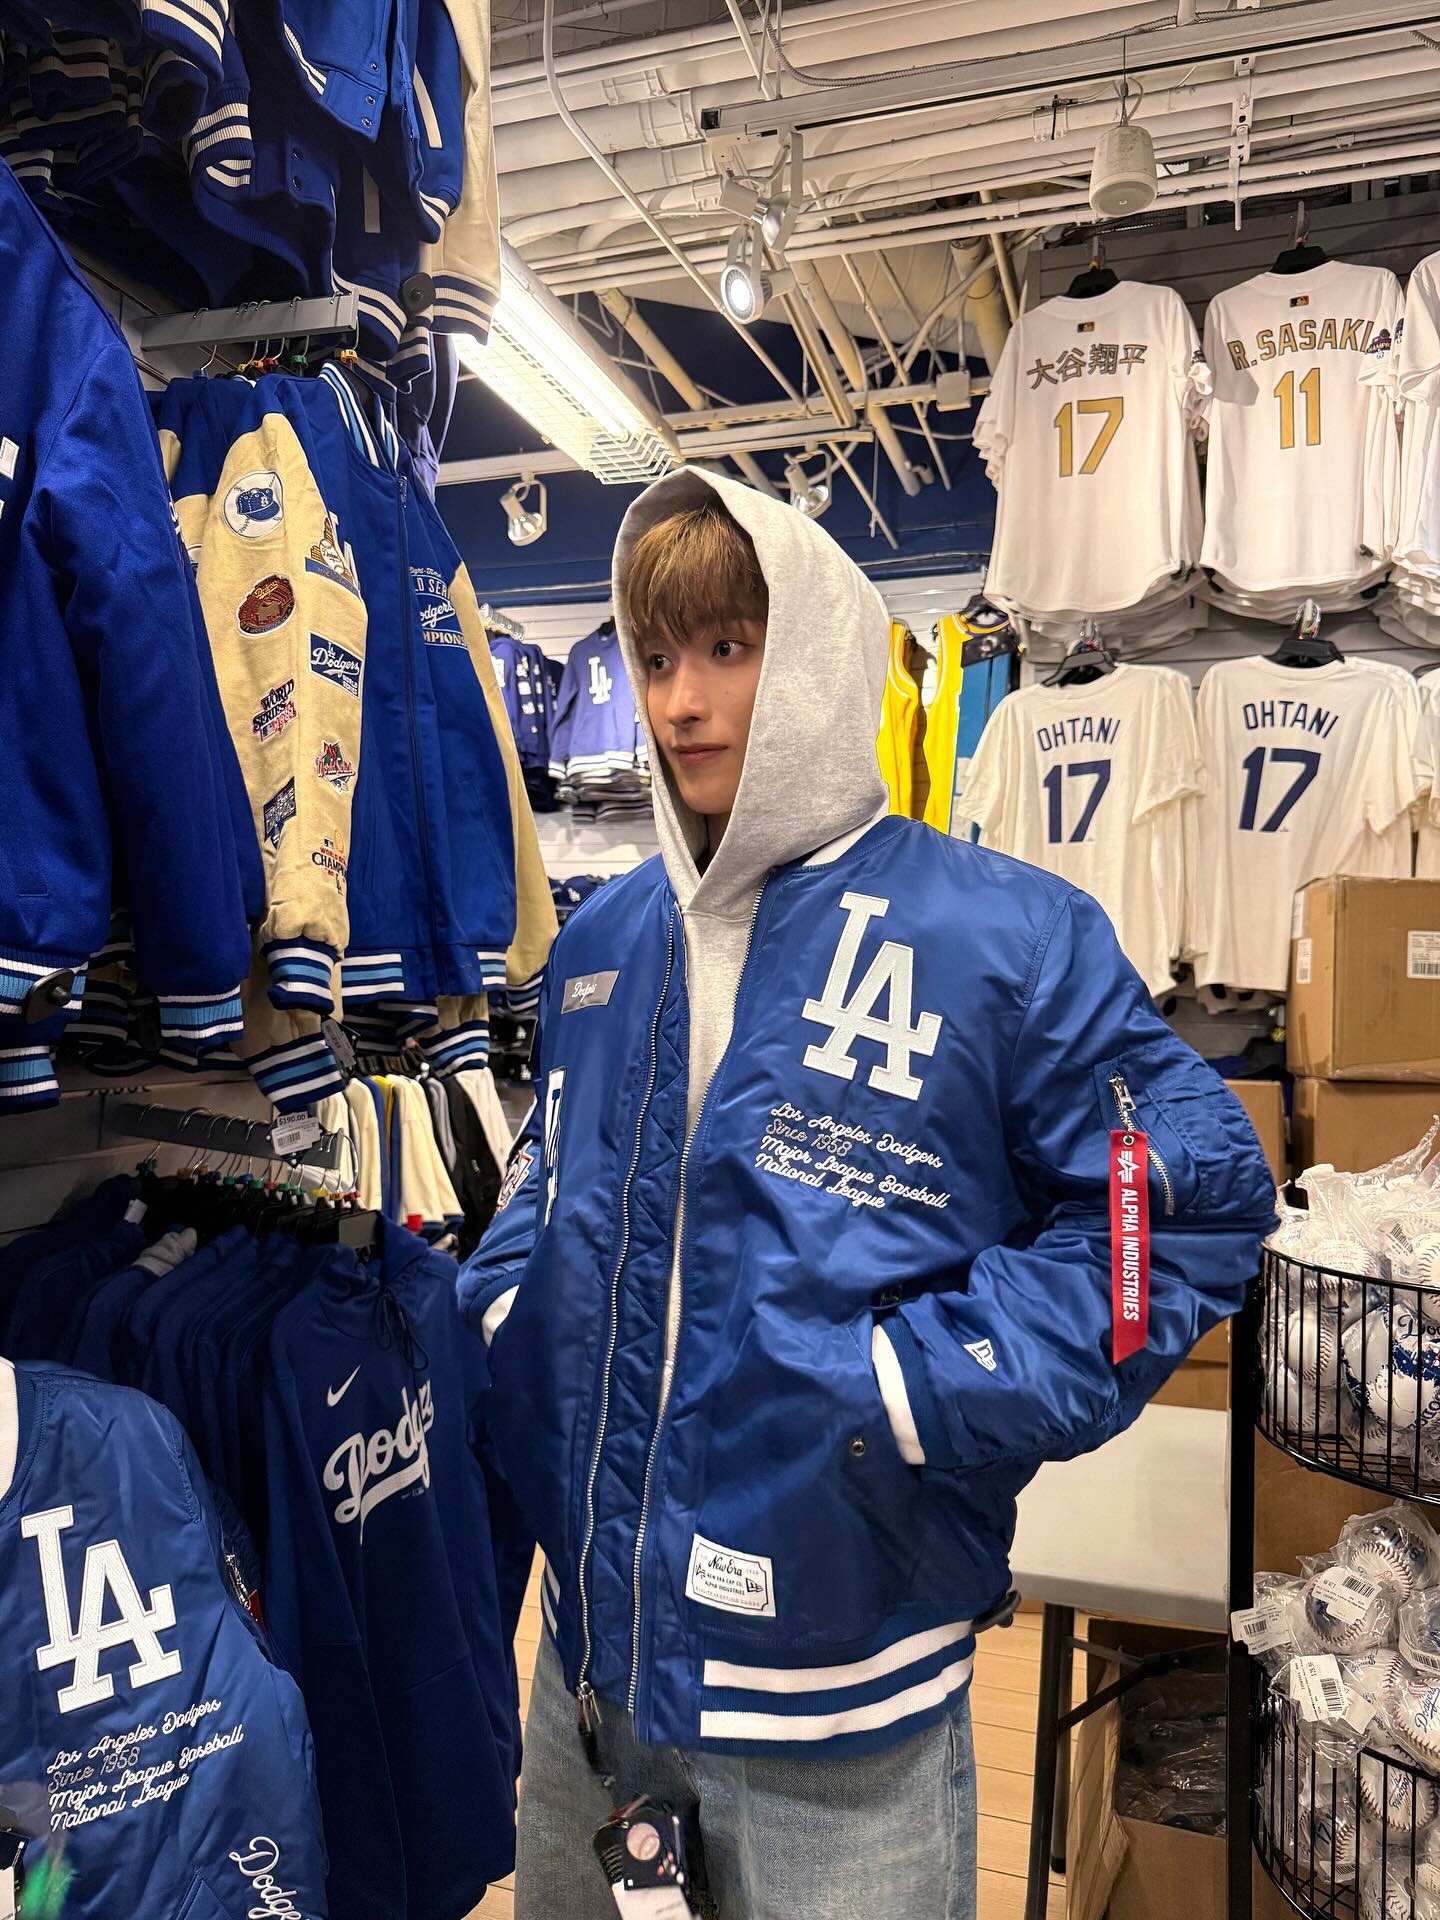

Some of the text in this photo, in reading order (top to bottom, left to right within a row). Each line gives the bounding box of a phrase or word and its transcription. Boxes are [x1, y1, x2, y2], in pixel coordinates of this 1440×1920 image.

[1026, 343, 1147, 391] 大谷翔平
[1227, 318, 1375, 372] R.SASAKI
[1053, 396, 1124, 479] 17
[1273, 367, 1321, 450] 11
[588, 656, 613, 705] LA
[1037, 717, 1120, 752] OHTANI
[1243, 701, 1338, 738] OHTANI
[1043, 759, 1112, 843] 17
[1238, 746, 1321, 833] 17
[801, 891, 943, 1101] LA
[765, 1118, 853, 1157] Since 1958
[770, 1102, 944, 1169] Los Angeles Dodgers
[754, 1152, 886, 1209] National League
[760, 1134, 951, 1209] Major League Baseball
[1121, 1188, 1140, 1321] ALPHA INDUSTRIES
[708, 1555, 727, 1573] New
[726, 1559, 743, 1576] Era
[21, 1505, 183, 1714] LA
[47, 1699, 221, 1774] Los Angeles Dodgers
[48, 1746, 140, 1793] Since 1958
[49, 1724, 244, 1812] Major League Baseball
[51, 1773, 189, 1832] National League
